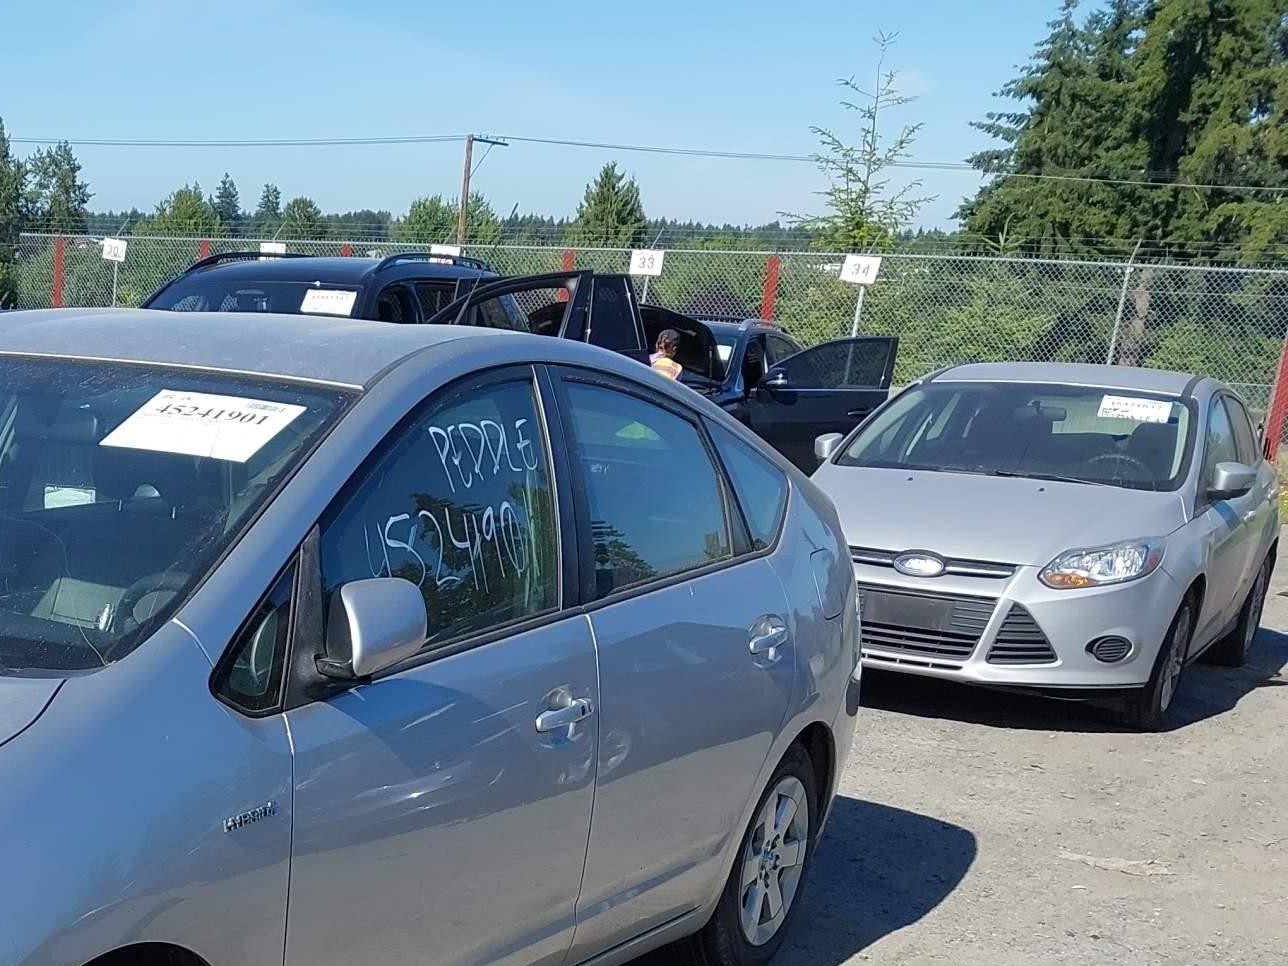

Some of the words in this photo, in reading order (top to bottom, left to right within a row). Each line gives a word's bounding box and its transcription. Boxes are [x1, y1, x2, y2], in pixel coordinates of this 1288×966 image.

[638, 255, 655, 269] 33
[851, 263, 870, 277] 34
[155, 403, 270, 426] 45241901
[428, 418, 538, 494] PEDDLE
